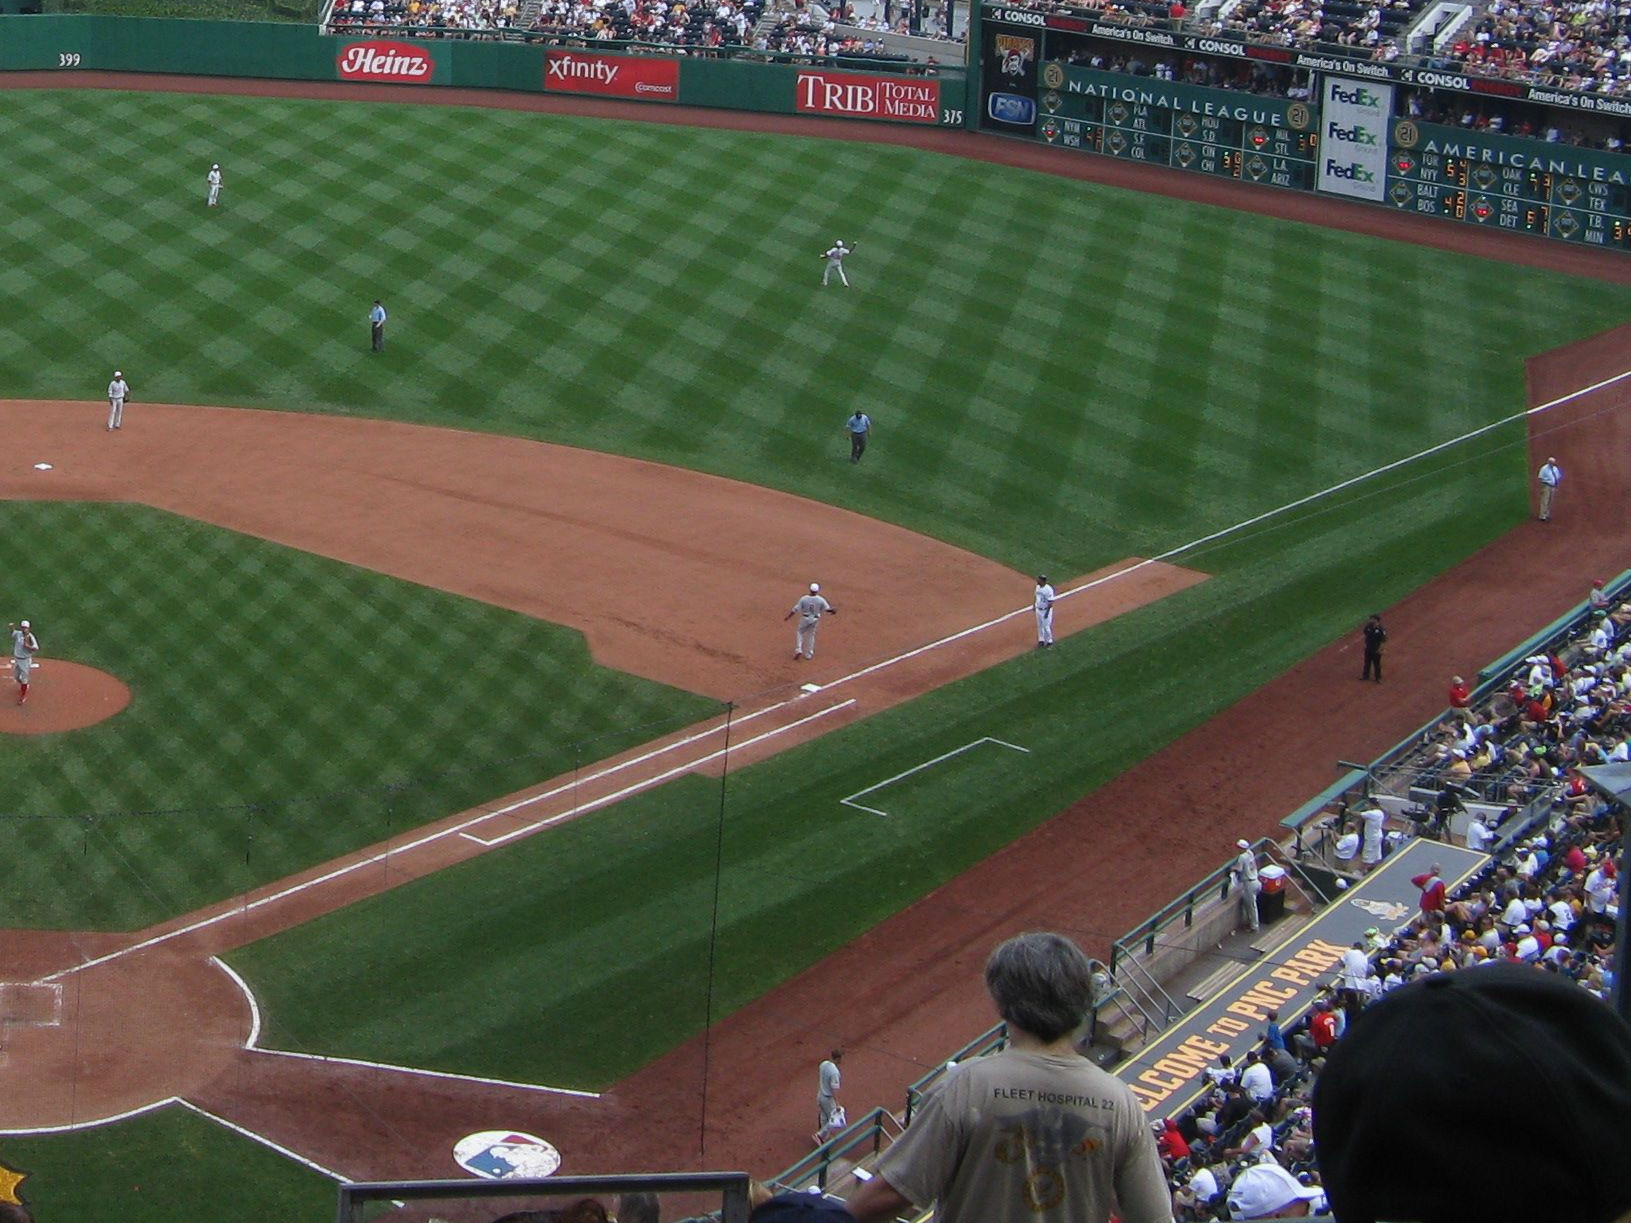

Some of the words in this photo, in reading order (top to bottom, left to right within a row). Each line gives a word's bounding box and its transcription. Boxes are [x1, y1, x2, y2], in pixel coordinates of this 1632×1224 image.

[1005, 10, 1047, 26] CONSOL
[1092, 24, 1132, 40] America's
[1132, 30, 1144, 41] On
[1199, 40, 1246, 56] CONSOL
[59, 53, 81, 67] 399
[341, 48, 428, 76] Heinz
[548, 56, 618, 85] xfinity
[1297, 54, 1341, 70] America's
[1342, 61, 1356, 72] On
[881, 82, 936, 101] TOTAL
[1417, 72, 1471, 90] CONSOL
[797, 74, 875, 112] TRIB
[1069, 80, 1182, 110] NATIONAL
[1192, 100, 1280, 126] LEAGUE
[1331, 85, 1380, 108] FedEx
[1528, 88, 1578, 107] America's
[1580, 95, 1595, 109] On
[884, 99, 936, 119] MEDIA
[943, 109, 963, 124] 375
[994, 96, 1031, 116] FSN
[1328, 122, 1377, 146] FedEx
[1425, 140, 1566, 173] AMERICAN
[1326, 159, 1375, 184] FedEx
[1271, 939, 1352, 987] PARK
[1226, 980, 1299, 1022] PNC
[1206, 1015, 1250, 1038] TO
[993, 1088, 1035, 1100] FLEET
[1038, 1092, 1099, 1109] HOSPITAL
[1101, 1099, 1114, 1110] 22
